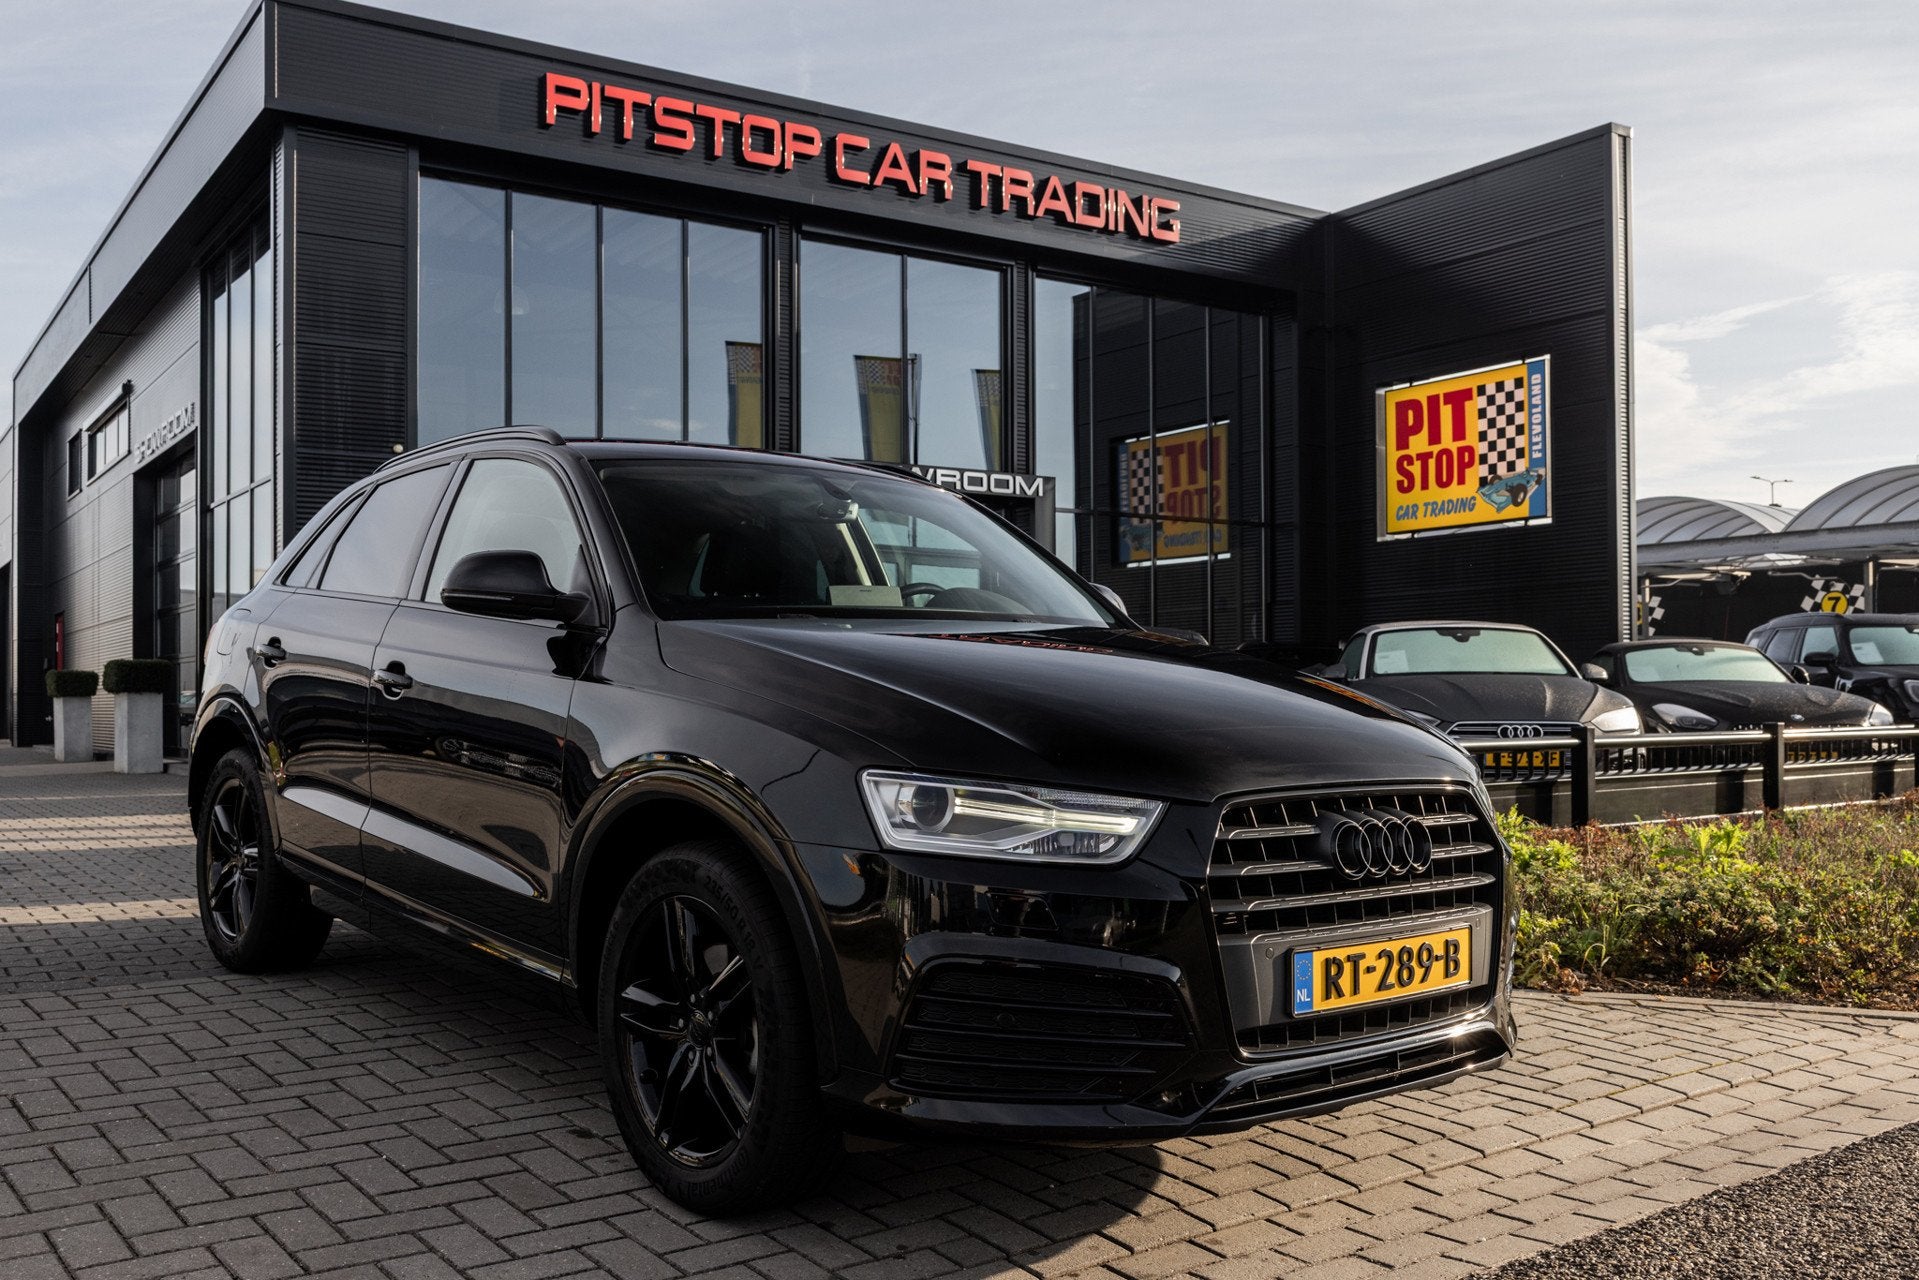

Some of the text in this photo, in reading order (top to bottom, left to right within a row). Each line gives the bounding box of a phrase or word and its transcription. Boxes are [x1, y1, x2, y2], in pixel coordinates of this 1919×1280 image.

[543, 72, 1181, 244] PITSTOP CAR TRADING
[1395, 387, 1474, 452] PIT
[1531, 373, 1542, 459] FLEVOLAND
[1396, 445, 1476, 494] STOP
[1396, 496, 1477, 521] CAR TRADING
[1826, 596, 1840, 612] 7
[1296, 989, 1311, 1003] NL
[1322, 938, 1461, 1002] RT-289-B
